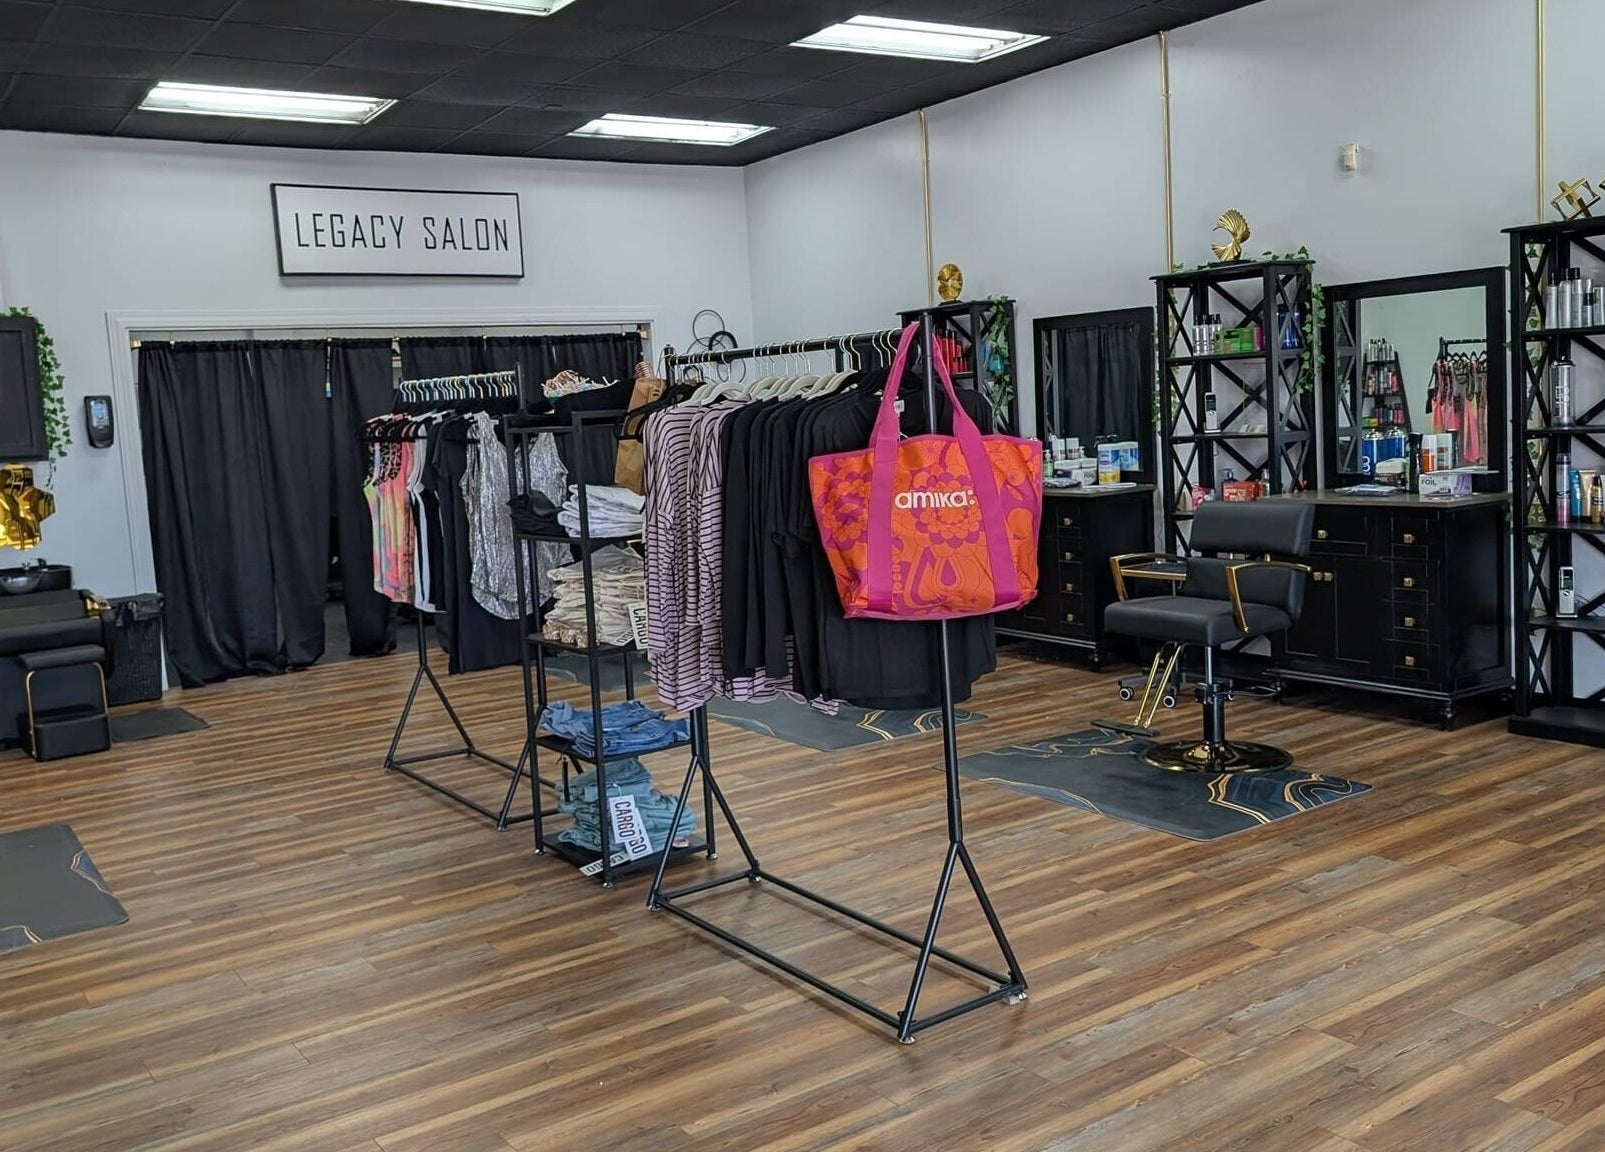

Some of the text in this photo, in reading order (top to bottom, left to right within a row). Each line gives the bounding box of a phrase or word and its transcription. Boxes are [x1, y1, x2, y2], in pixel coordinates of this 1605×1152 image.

[295, 212, 509, 252] LEGACY SALON
[614, 801, 636, 838] CARGO
